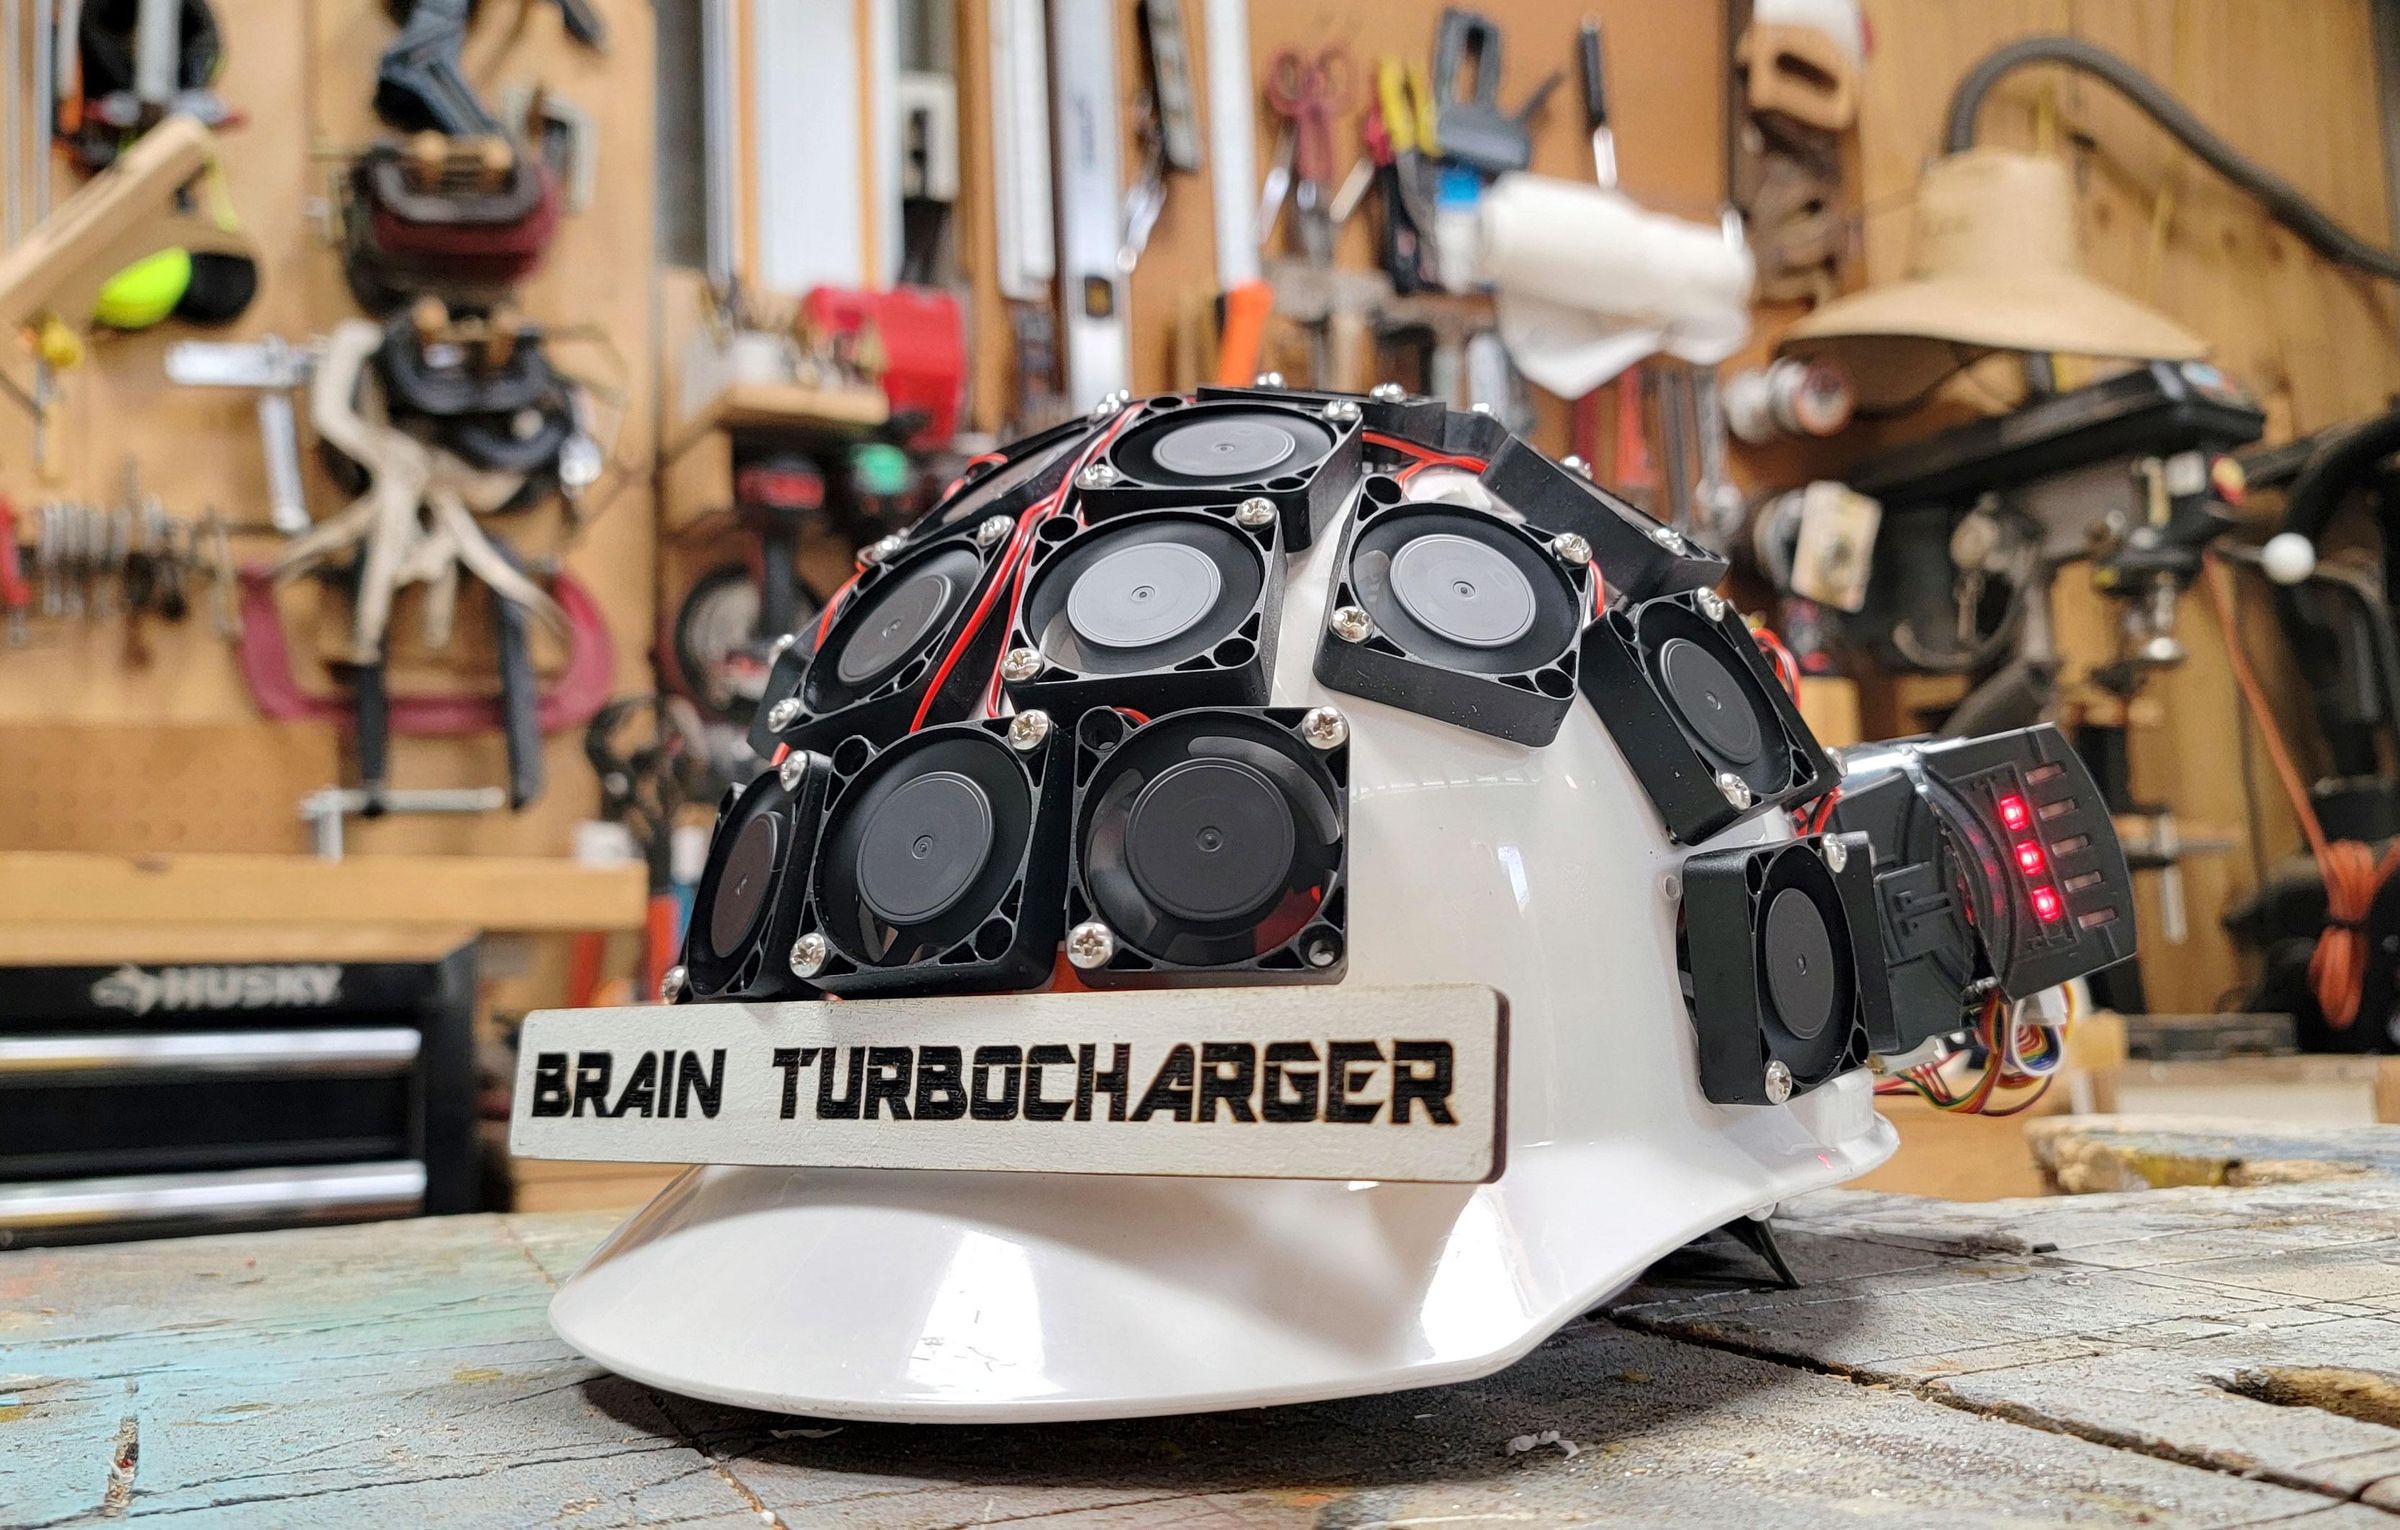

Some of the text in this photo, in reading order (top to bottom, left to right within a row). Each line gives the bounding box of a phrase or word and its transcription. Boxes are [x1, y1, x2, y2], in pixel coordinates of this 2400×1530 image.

[160, 965, 342, 1010] HUSKY
[531, 1040, 1459, 1125] BRAIN TURBOCHARGER
